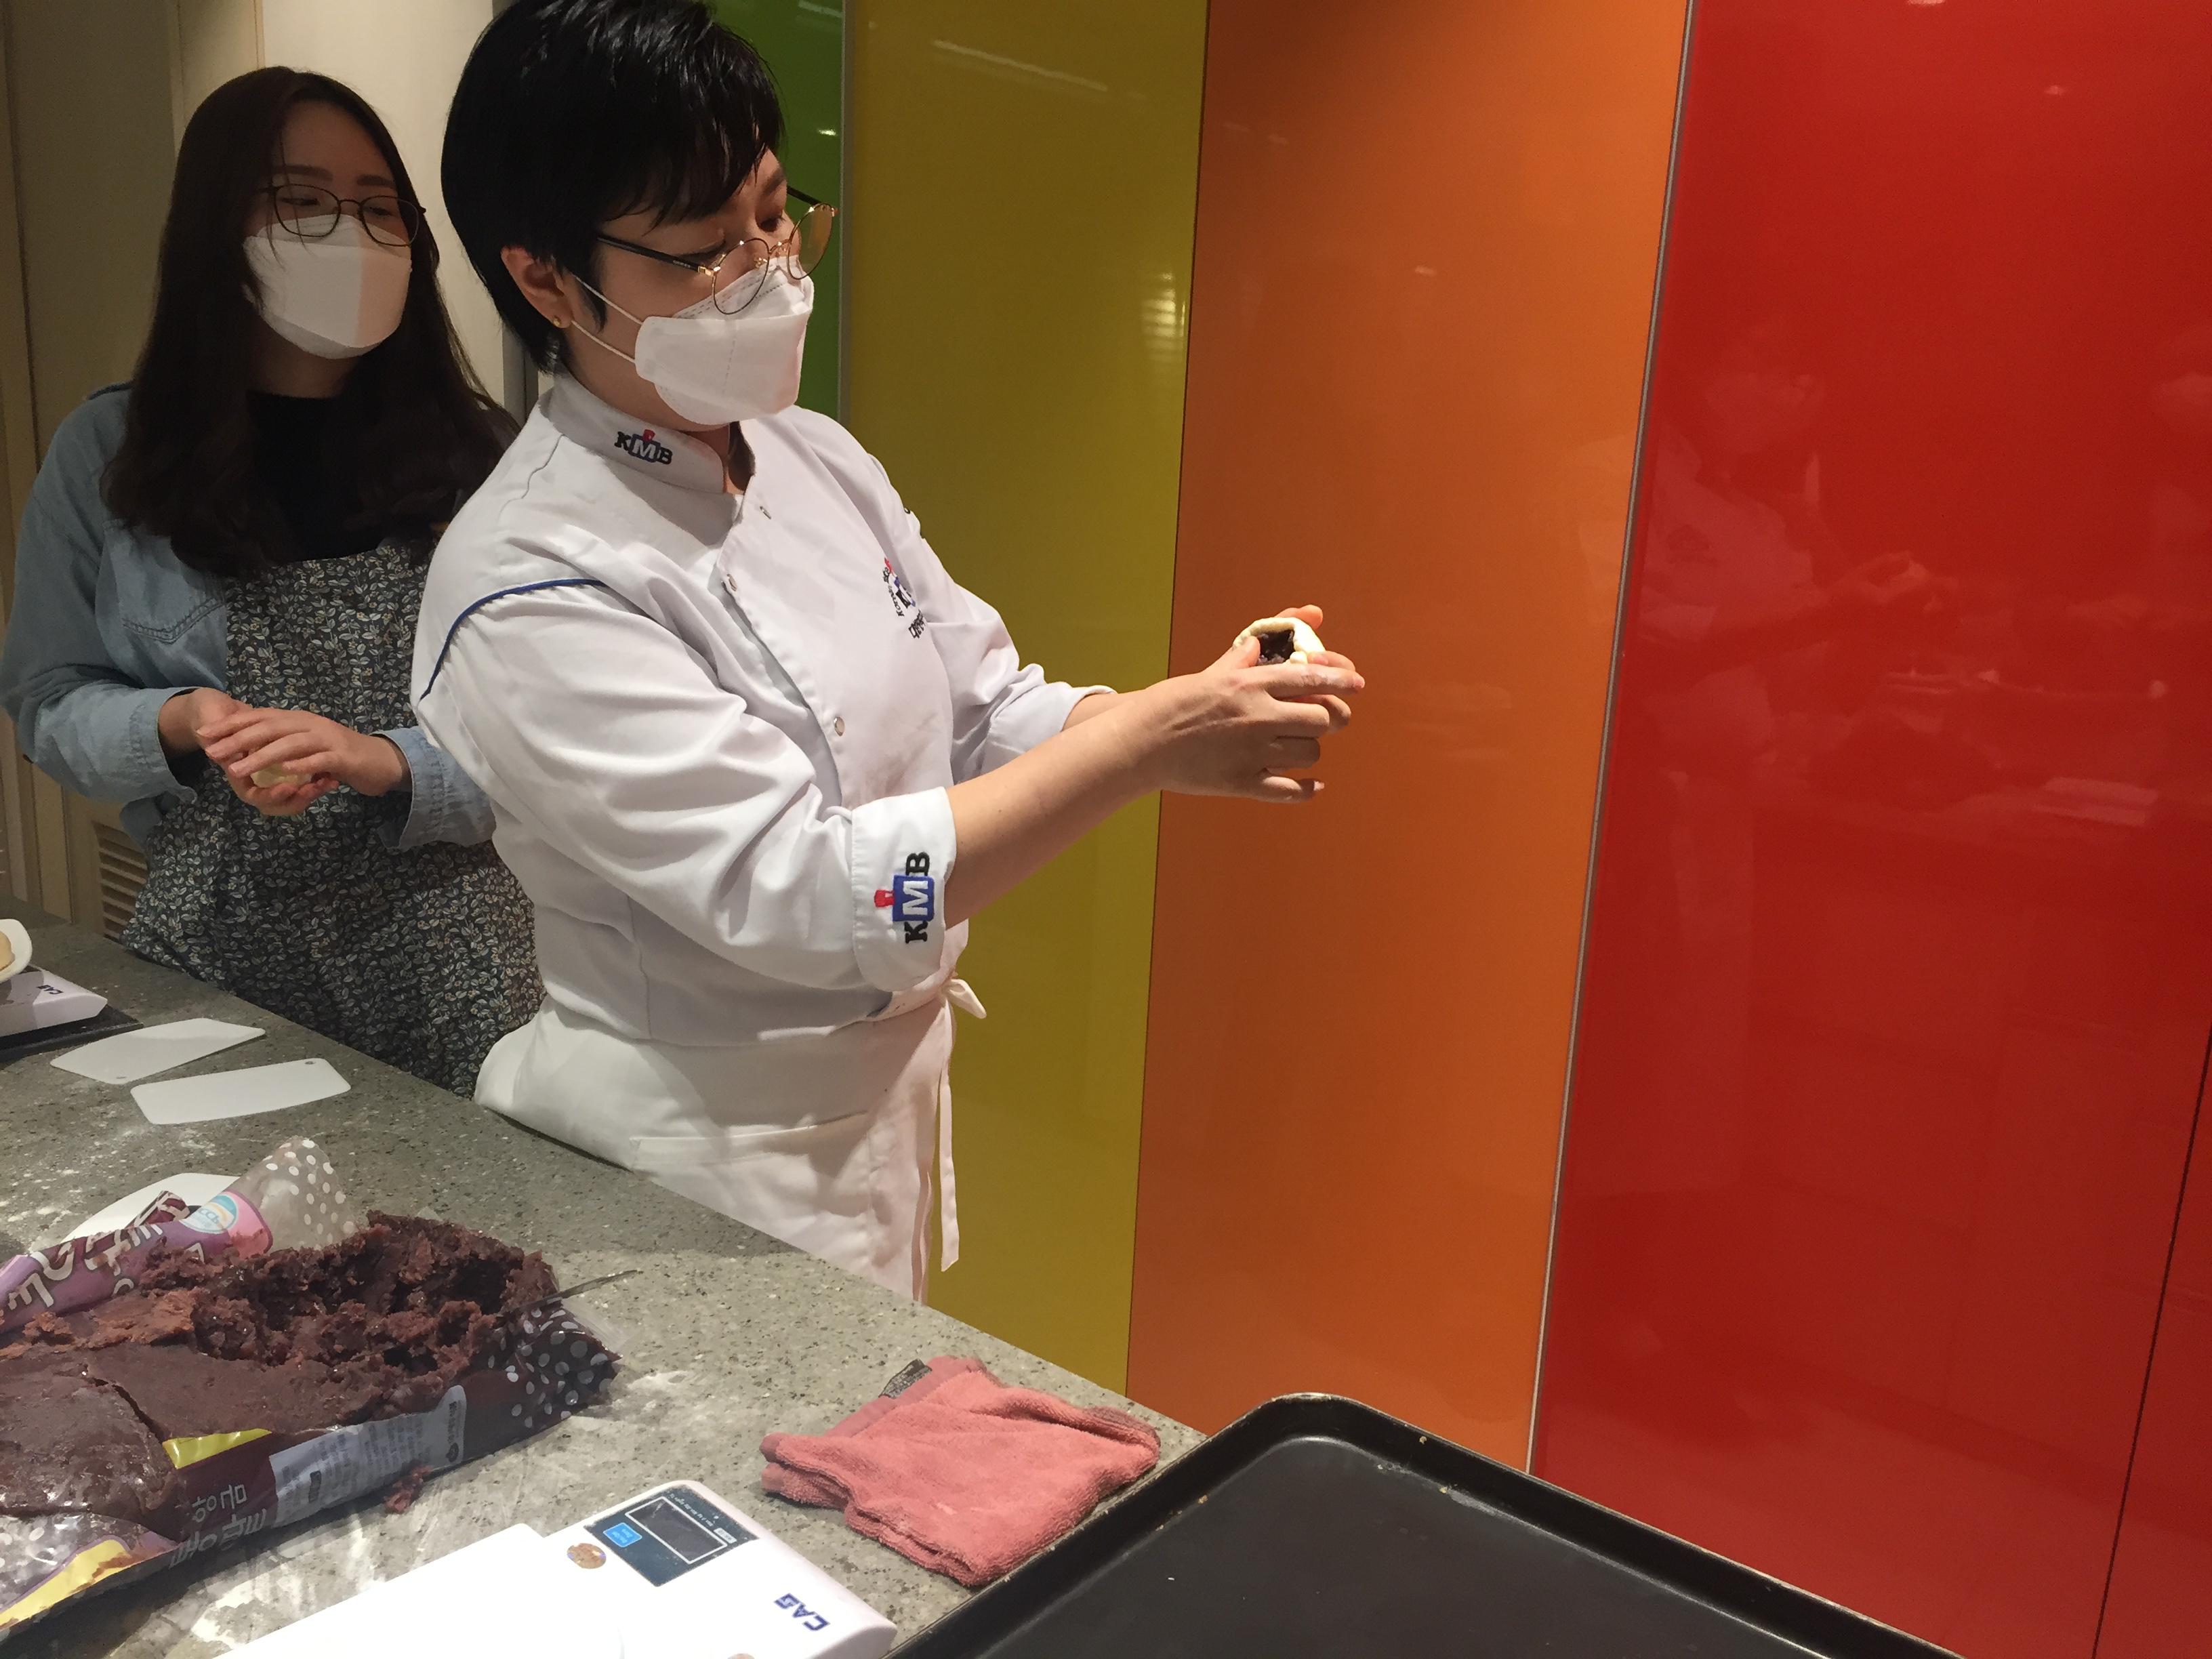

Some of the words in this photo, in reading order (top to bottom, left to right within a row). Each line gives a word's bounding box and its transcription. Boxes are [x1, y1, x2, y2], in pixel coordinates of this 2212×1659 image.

[614, 431, 673, 465] KMB
[902, 851, 932, 944] KMB
[773, 1593, 830, 1631] CAS
